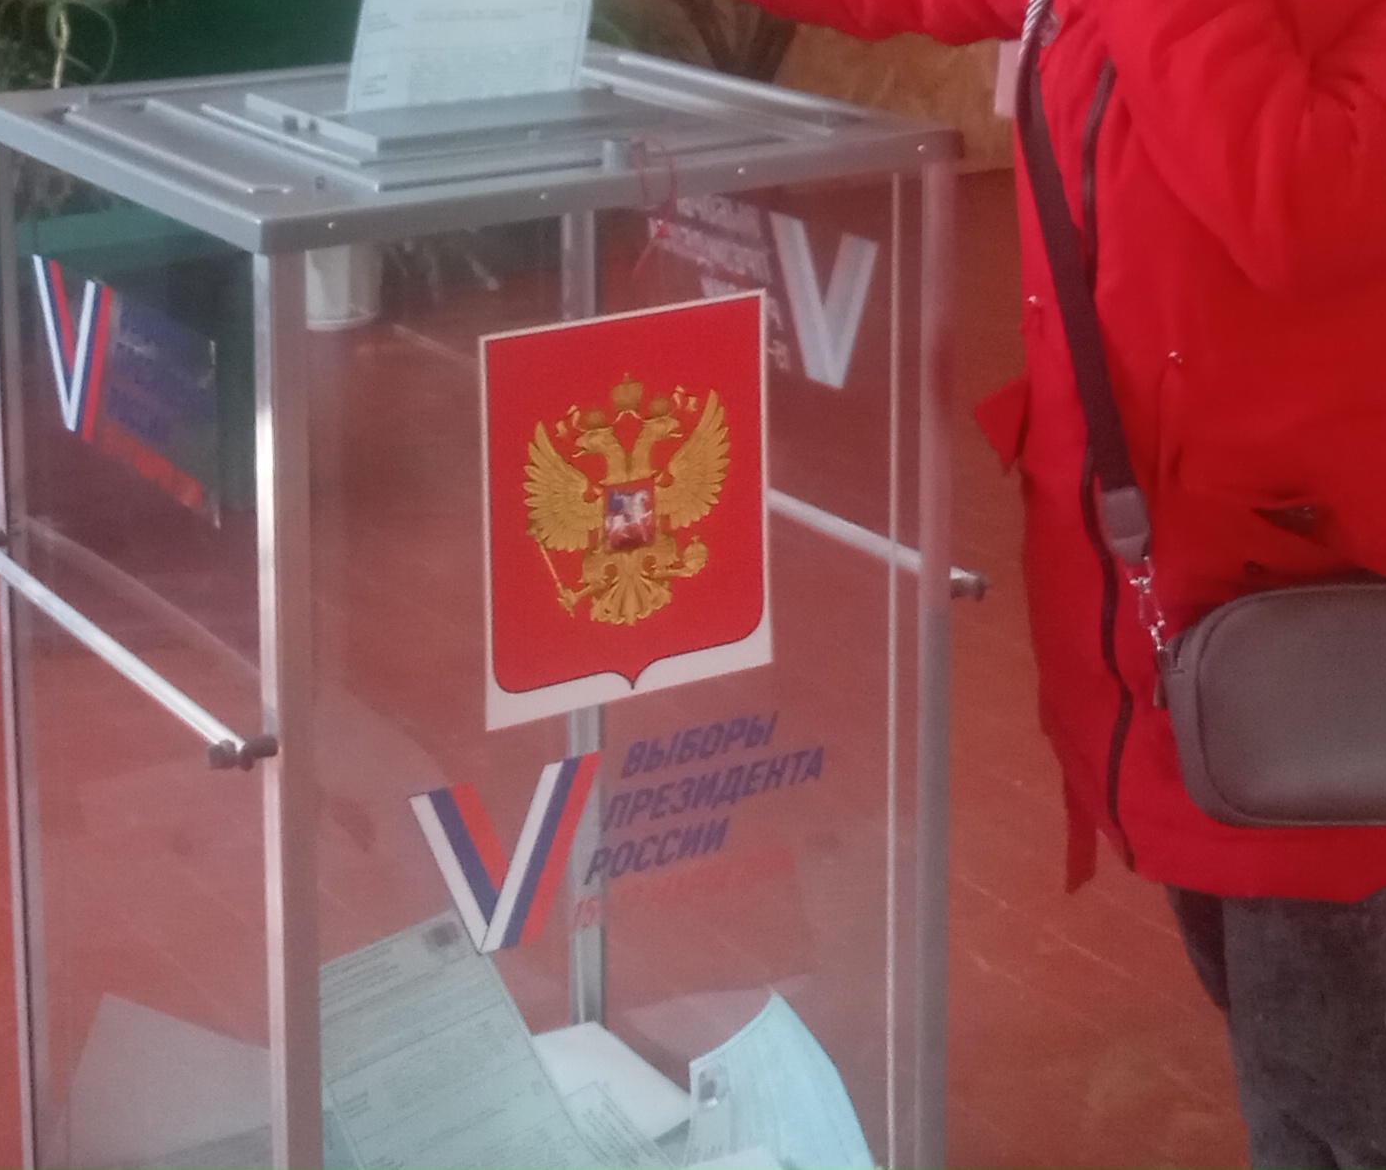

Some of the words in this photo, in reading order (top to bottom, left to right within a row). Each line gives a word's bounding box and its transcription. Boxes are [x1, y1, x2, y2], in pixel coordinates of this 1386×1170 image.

[620, 711, 779, 779] ВЫБОРЫ
[601, 745, 825, 833] ПРЕЗИДЕНТА
[584, 817, 730, 887] РОССИИ
